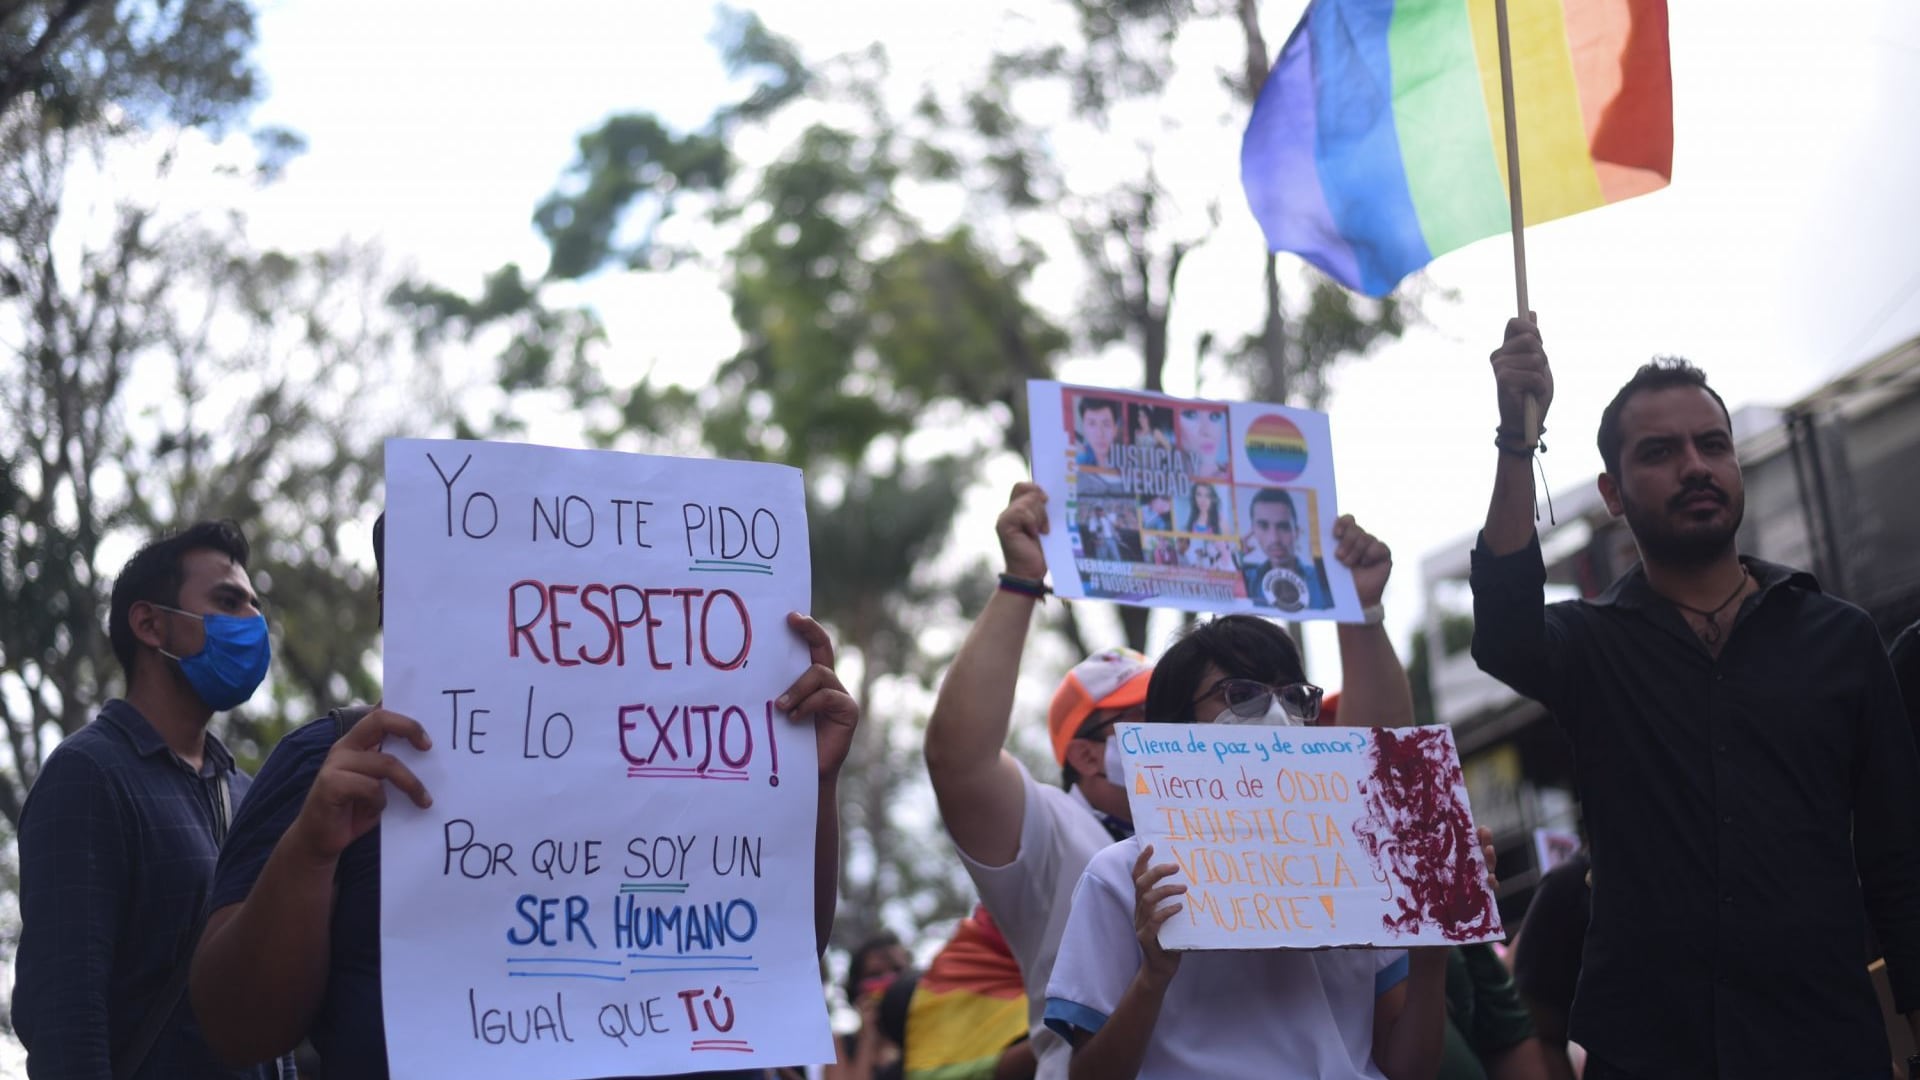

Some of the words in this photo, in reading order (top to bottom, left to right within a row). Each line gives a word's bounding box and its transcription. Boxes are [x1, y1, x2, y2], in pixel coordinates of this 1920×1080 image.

[1106, 443, 1183, 473] JUSTICIA
[1121, 467, 1189, 497] VERDAD
[532, 495, 595, 548] NO
[610, 499, 653, 548] TE
[683, 503, 780, 560] PIDO
[508, 579, 753, 670] RESPETO,
[442, 689, 490, 754] TE
[523, 685, 573, 759] LO
[1187, 730, 1207, 754] de
[1213, 738, 1251, 764] paz
[1255, 740, 1269, 762] y
[1272, 732, 1294, 754] de
[1302, 732, 1368, 755] amor?
[1236, 765, 1264, 799] de
[1277, 766, 1349, 803] ODIO
[1157, 807, 1345, 848] INJUSTICIA
[444, 819, 517, 879] POR
[532, 839, 601, 880] QUE
[624, 835, 696, 879] SOY
[712, 835, 762, 878] UN
[1171, 846, 1358, 888] VIOLENCIA
[507, 894, 598, 950] SER
[614, 894, 758, 954] HUMANO
[1184, 892, 1337, 932] MUERTE!
[598, 997, 670, 1048] QUE
[677, 986, 735, 1033] TÚ
